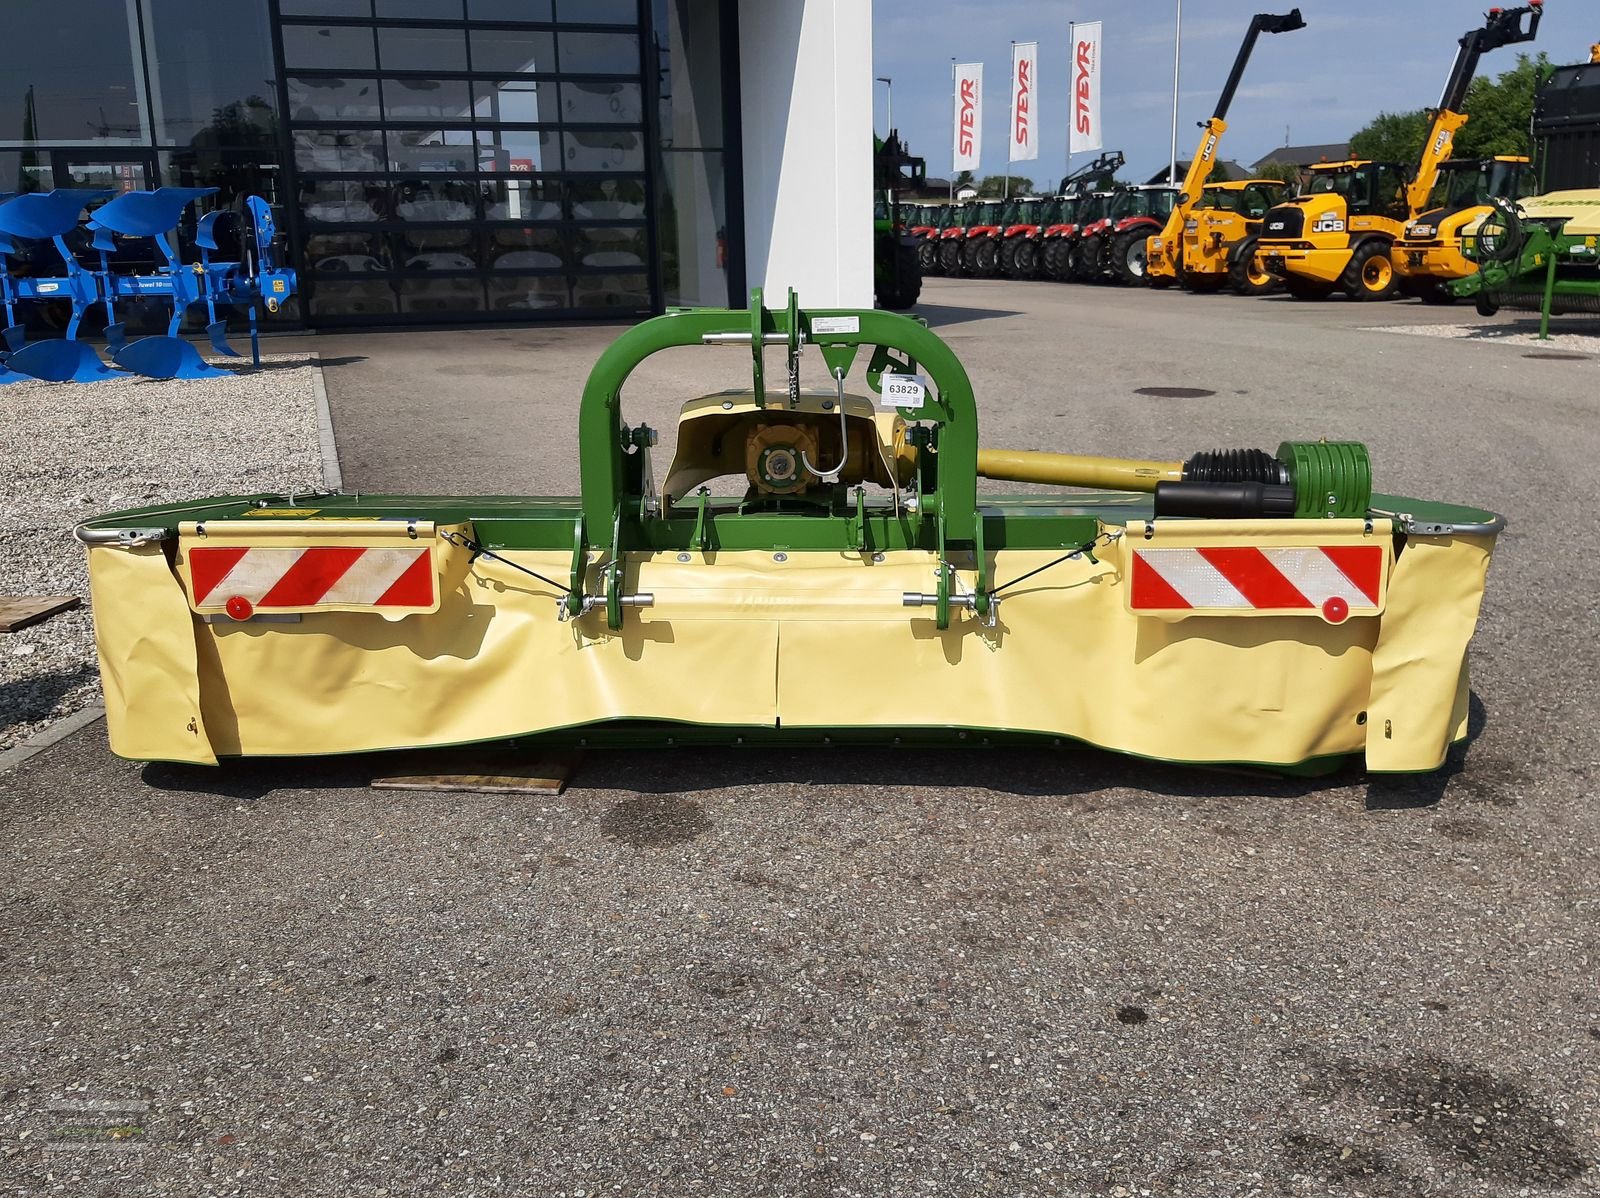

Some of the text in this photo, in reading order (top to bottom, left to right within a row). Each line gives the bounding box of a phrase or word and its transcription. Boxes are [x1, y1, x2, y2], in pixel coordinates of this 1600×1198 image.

[1076, 40, 1091, 136] STEYR
[1016, 59, 1030, 147] STEYR
[959, 78, 975, 158] STEYR
[1202, 135, 1217, 160] JCB
[510, 164, 528, 172] EYR
[1269, 222, 1285, 231] JCB
[1312, 220, 1344, 232] JCB
[889, 384, 919, 395] 63829
